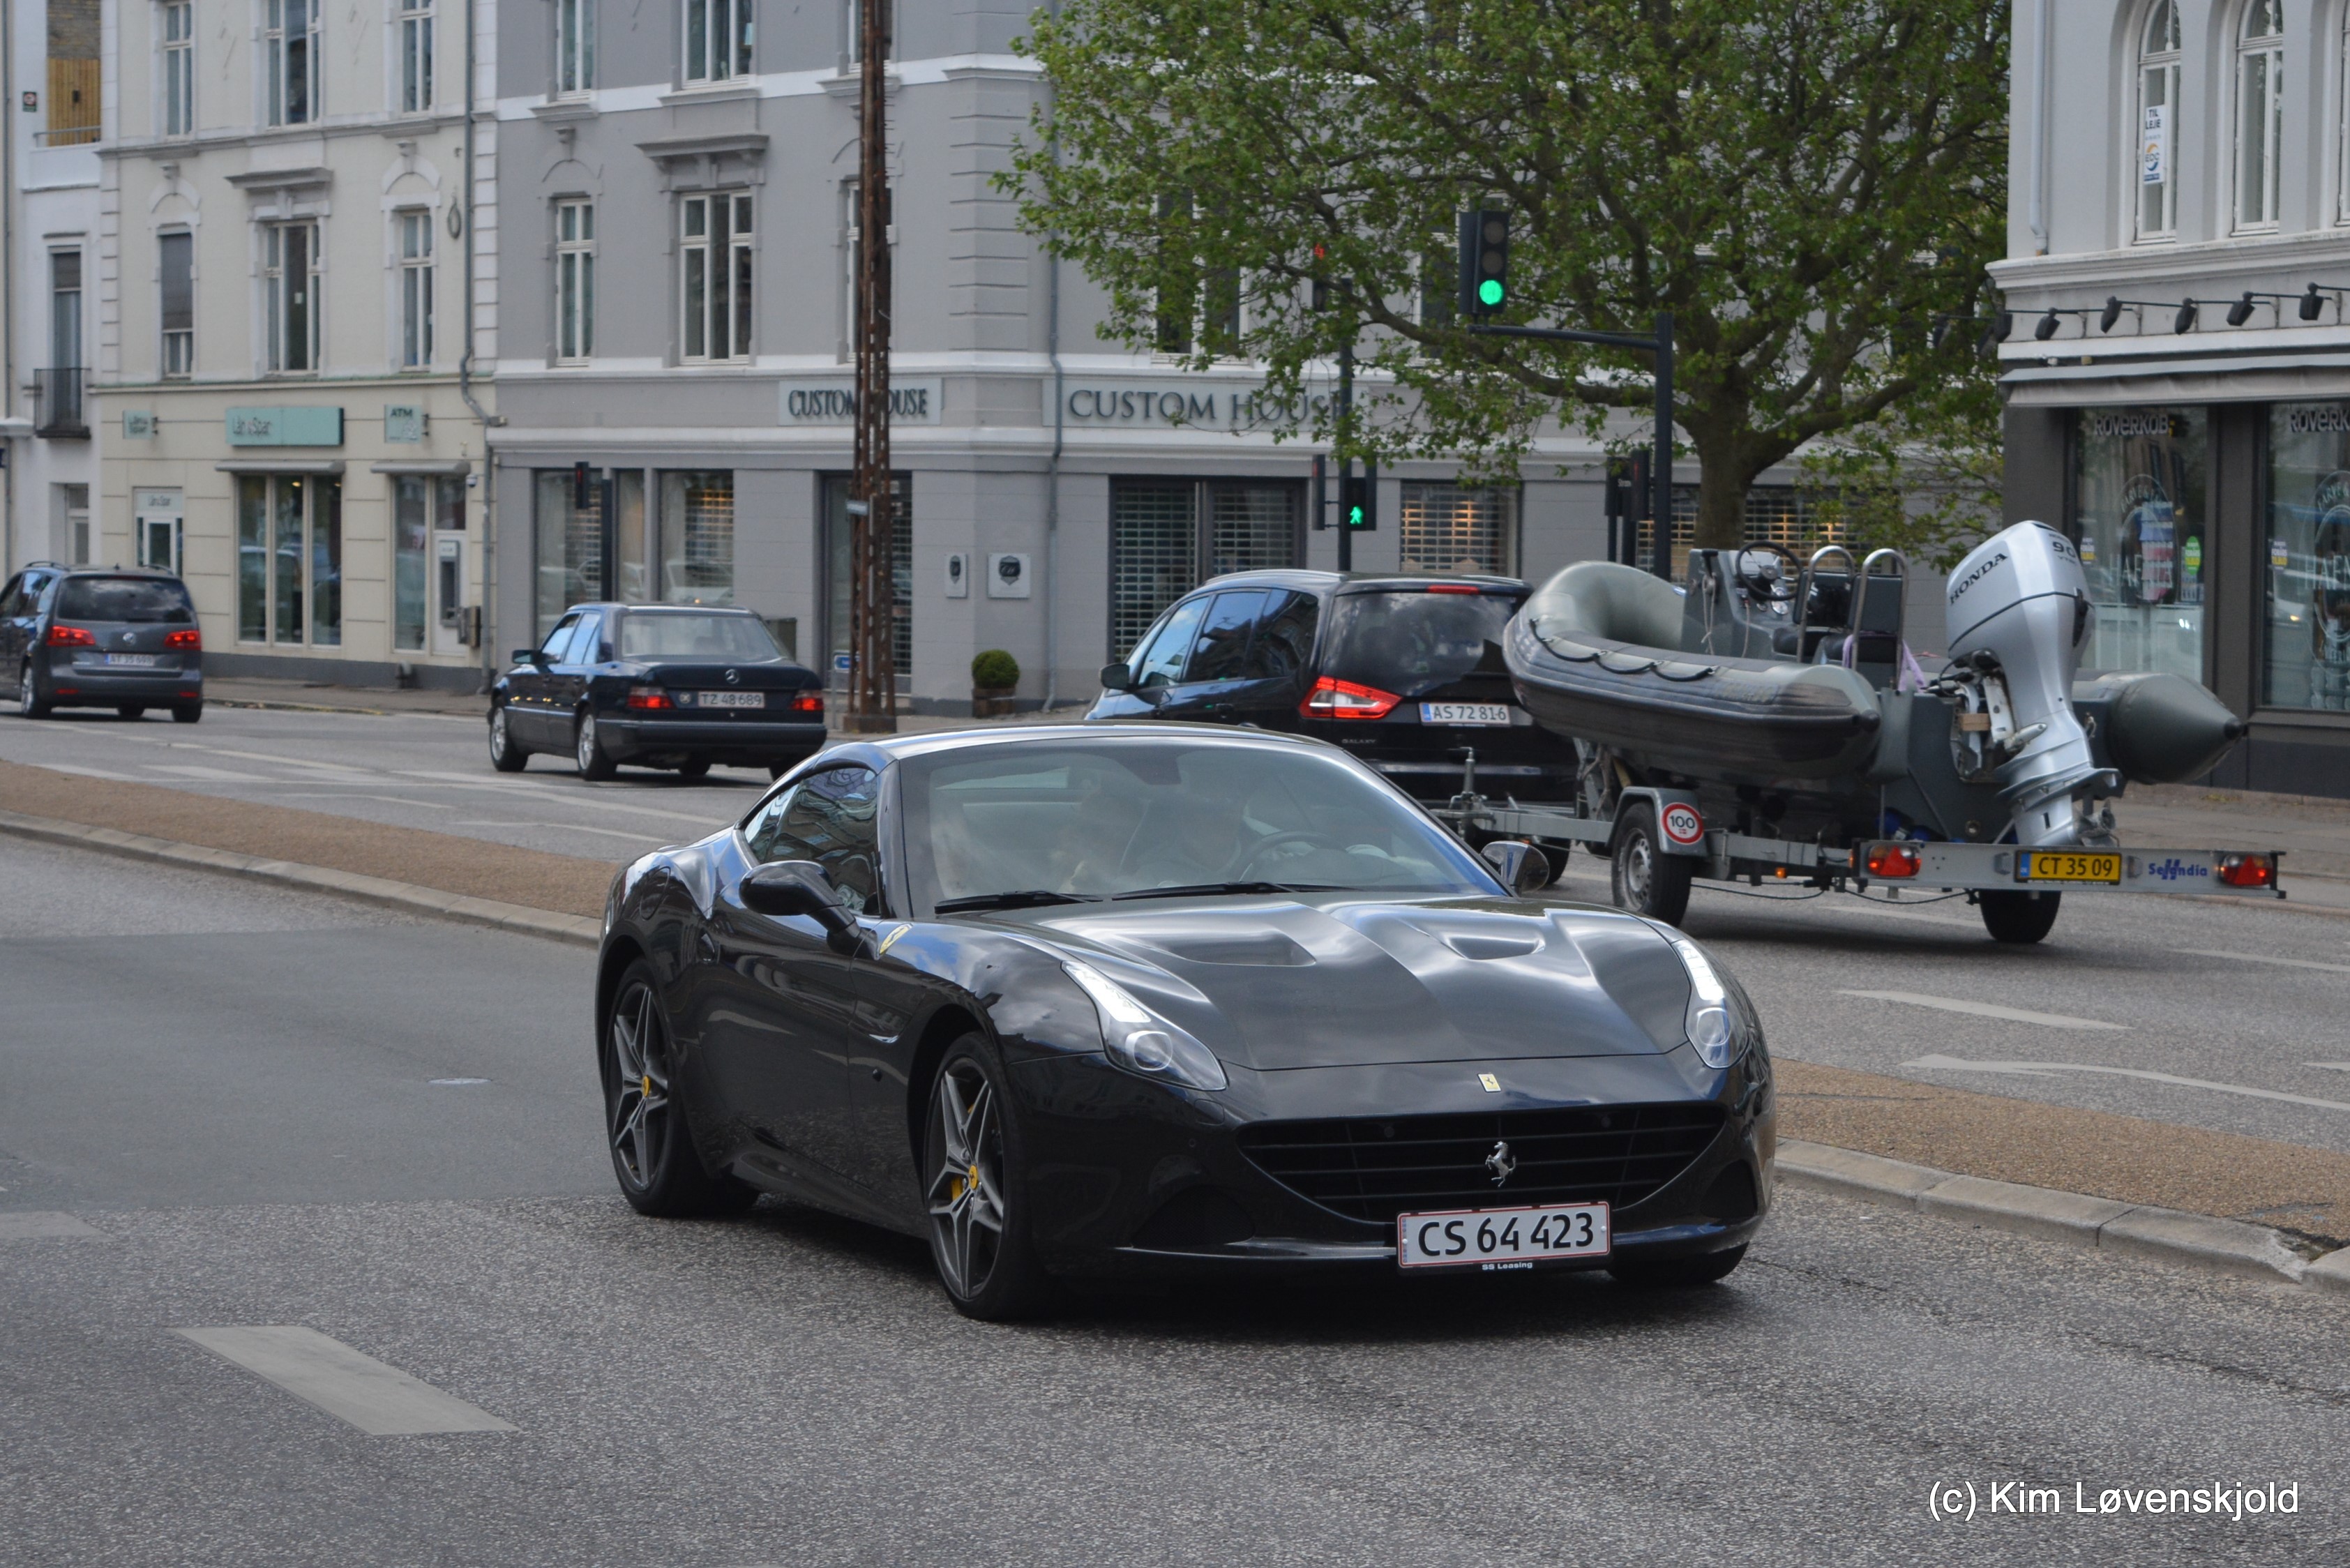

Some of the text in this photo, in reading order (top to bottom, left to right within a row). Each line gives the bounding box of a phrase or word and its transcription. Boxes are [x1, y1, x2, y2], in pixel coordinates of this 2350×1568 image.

[2149, 108, 2159, 118] TIL
[2146, 119, 2161, 130] LEJE
[1069, 389, 1217, 420] CUSTOM
[391, 408, 413, 417] ATM
[2052, 541, 2077, 558] 90
[1950, 553, 2008, 605] HONDA
[700, 694, 762, 706] TZ 48 689
[1433, 706, 1453, 719] AS
[1458, 706, 1475, 720] 72
[1479, 707, 1507, 721] 816
[1670, 815, 1695, 829] 100
[2038, 856, 2112, 876] CT 35 09
[1418, 1212, 1594, 1256] CS 64 423
[1497, 1261, 1533, 1270] Leasing
